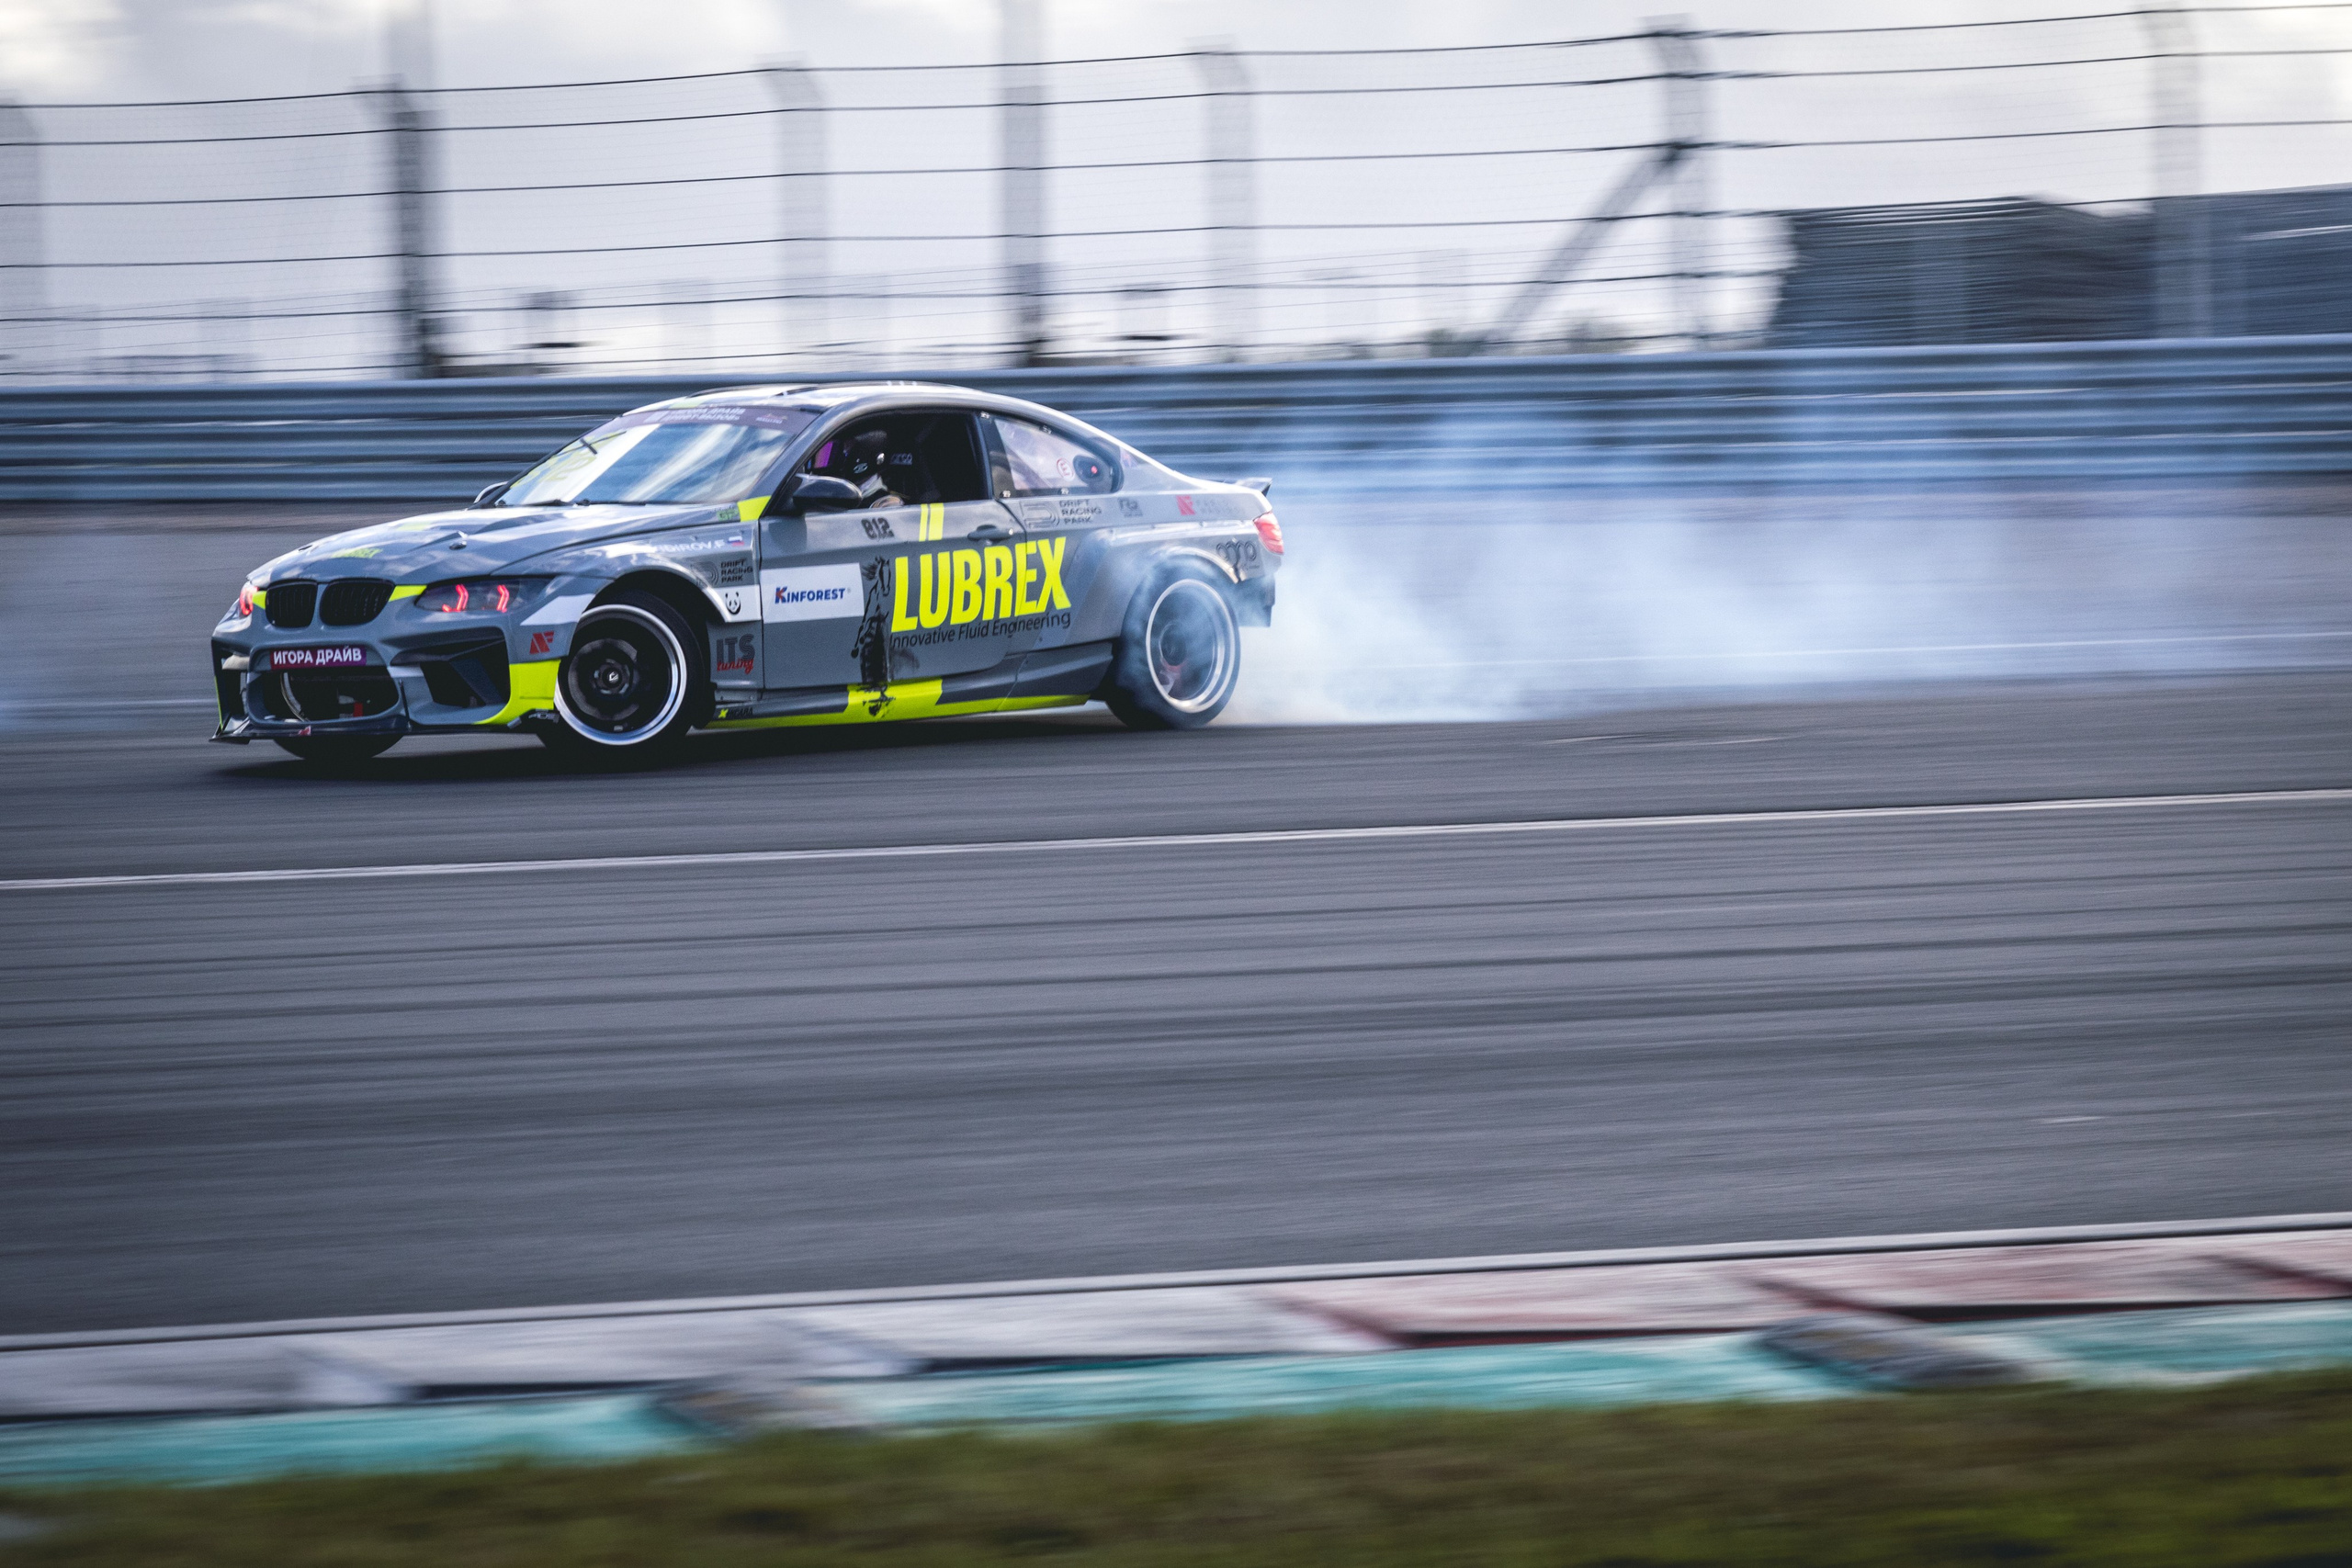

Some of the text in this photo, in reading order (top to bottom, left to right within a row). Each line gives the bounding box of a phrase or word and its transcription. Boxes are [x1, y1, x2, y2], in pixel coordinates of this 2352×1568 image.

[1058, 499, 1091, 508] DRIFT
[1061, 507, 1102, 516] RACING
[1064, 516, 1092, 525] PARK
[720, 558, 747, 568] DRIFT
[720, 566, 753, 577] RACING
[721, 575, 743, 583] PARK
[891, 536, 1071, 633] LUBREX
[775, 586, 846, 604] KINFOREST
[889, 611, 1071, 649] Innovative Fluid Engineering
[717, 633, 755, 662] ITS
[273, 645, 362, 665] ИГОРА ДРАЙВ
[717, 657, 754, 674] tuning
